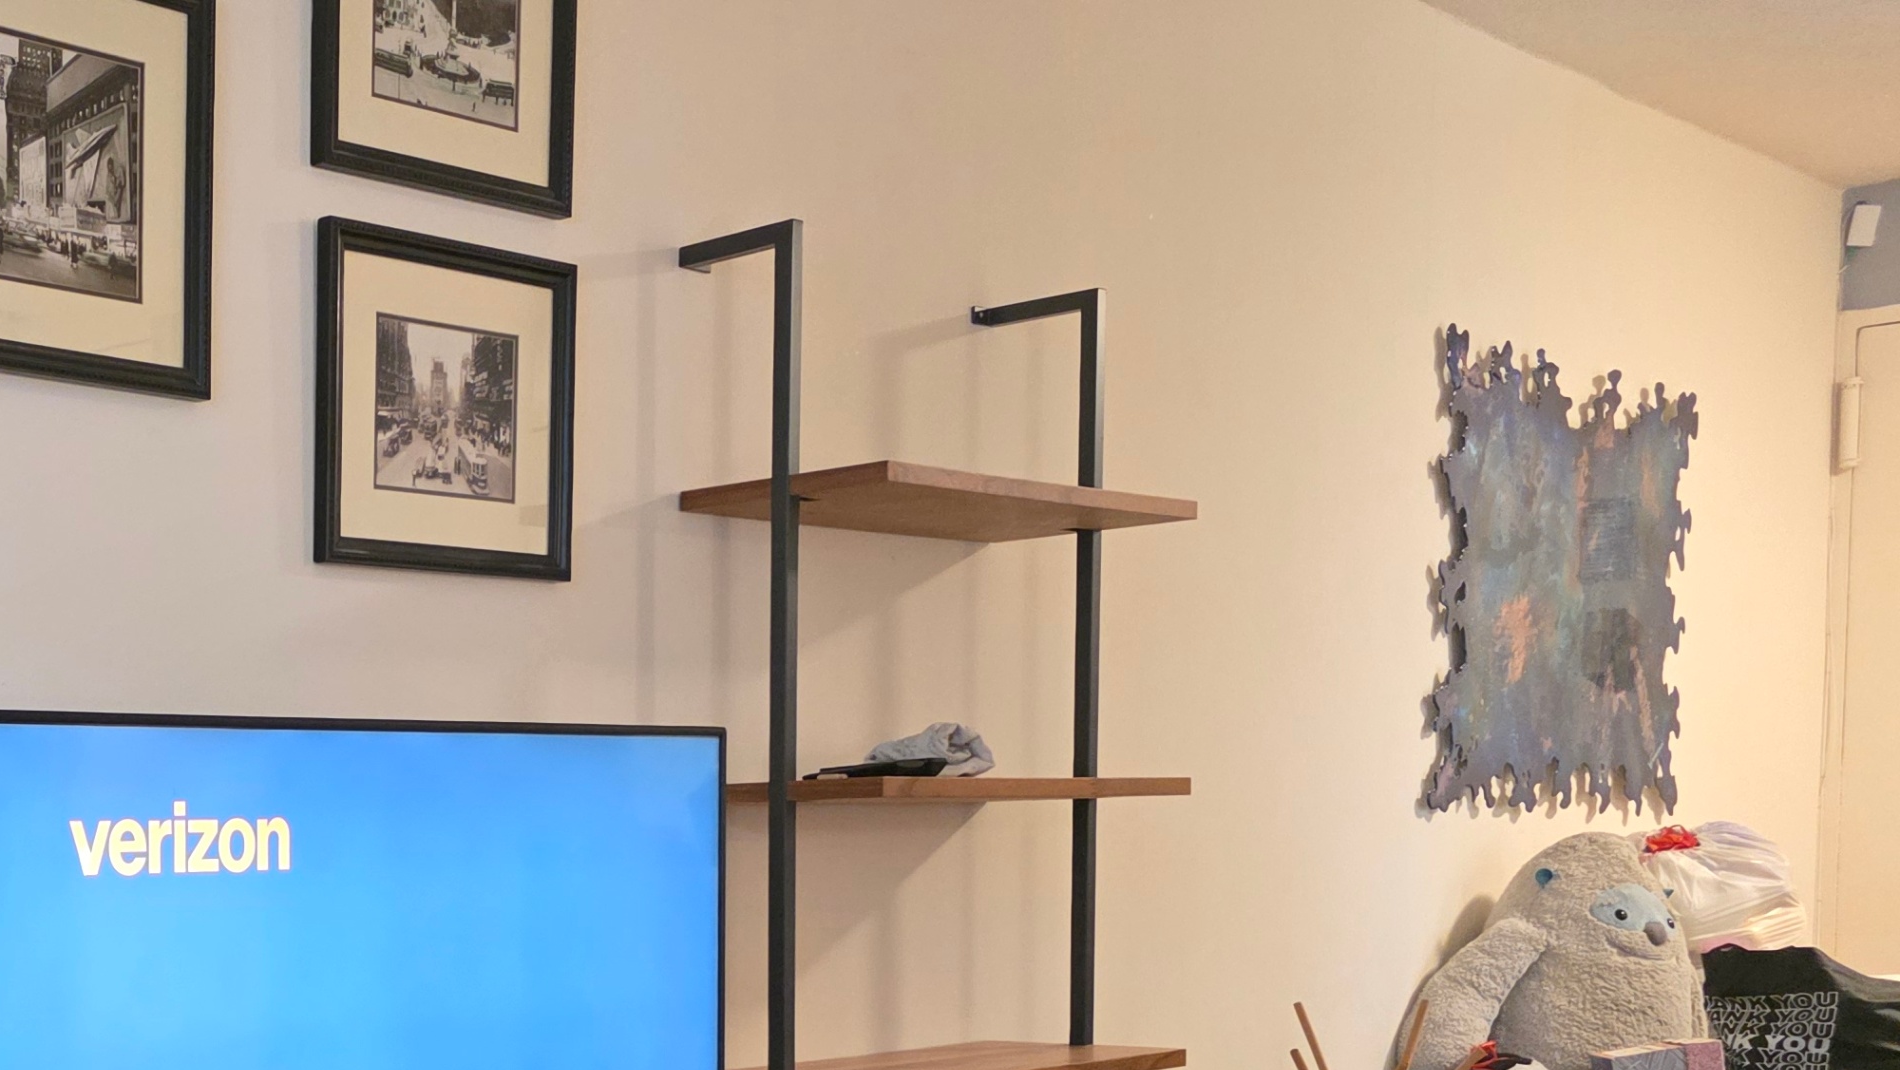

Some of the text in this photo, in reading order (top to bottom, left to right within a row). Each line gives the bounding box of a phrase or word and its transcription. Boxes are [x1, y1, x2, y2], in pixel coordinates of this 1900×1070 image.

[69, 800, 291, 877] verizon
[1771, 992, 1839, 1010] YOU
[1775, 1007, 1838, 1024] YOU
[1770, 1021, 1835, 1039] YOU
[1765, 1035, 1831, 1052] YOU
[1758, 1048, 1830, 1065] YOU
